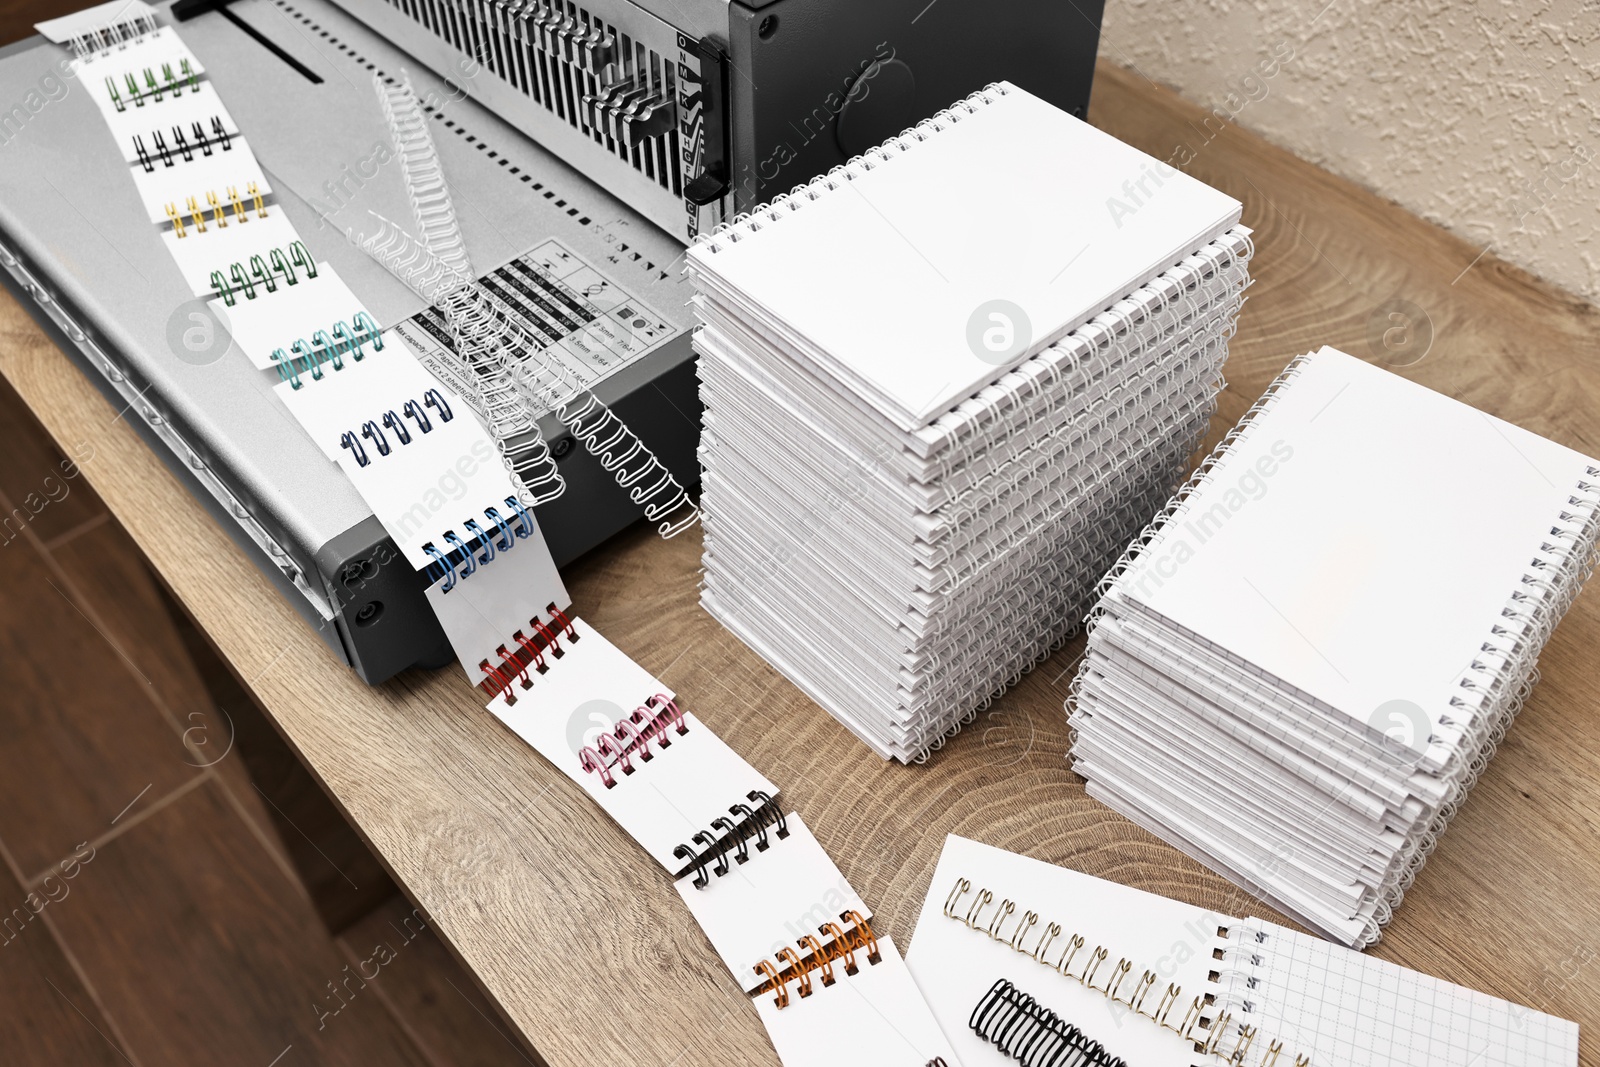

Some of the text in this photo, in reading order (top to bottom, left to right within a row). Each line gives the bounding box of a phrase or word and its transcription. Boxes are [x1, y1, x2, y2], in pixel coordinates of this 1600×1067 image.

[679, 36, 686, 47] O
[680, 51, 686, 63] N
[680, 66, 688, 79] M
[682, 80, 687, 92] L
[681, 95, 688, 107] K
[683, 111, 688, 120] J
[684, 138, 690, 149] H
[684, 151, 691, 161] G
[686, 165, 691, 173] F
[687, 203, 693, 212] C
[689, 216, 694, 226] B
[507, 278, 530, 294] 50-70
[531, 296, 556, 313] 9.5mm
[547, 287, 572, 304] 6.4mm
[555, 283, 579, 300] 4.8mm
[490, 286, 517, 305] 90-110
[515, 305, 542, 325] 12.7mm
[540, 292, 564, 309] 7.9mm
[524, 301, 550, 320] 11.1mm
[507, 310, 534, 330] 14.3mm
[422, 322, 451, 343] 310-350
[591, 321, 636, 354] 2.5mm 7/64"
[401, 333, 430, 355] capacity:
[567, 335, 592, 354] 3.5mm
[423, 358, 441, 372] PVC
[434, 351, 458, 368] Paper
